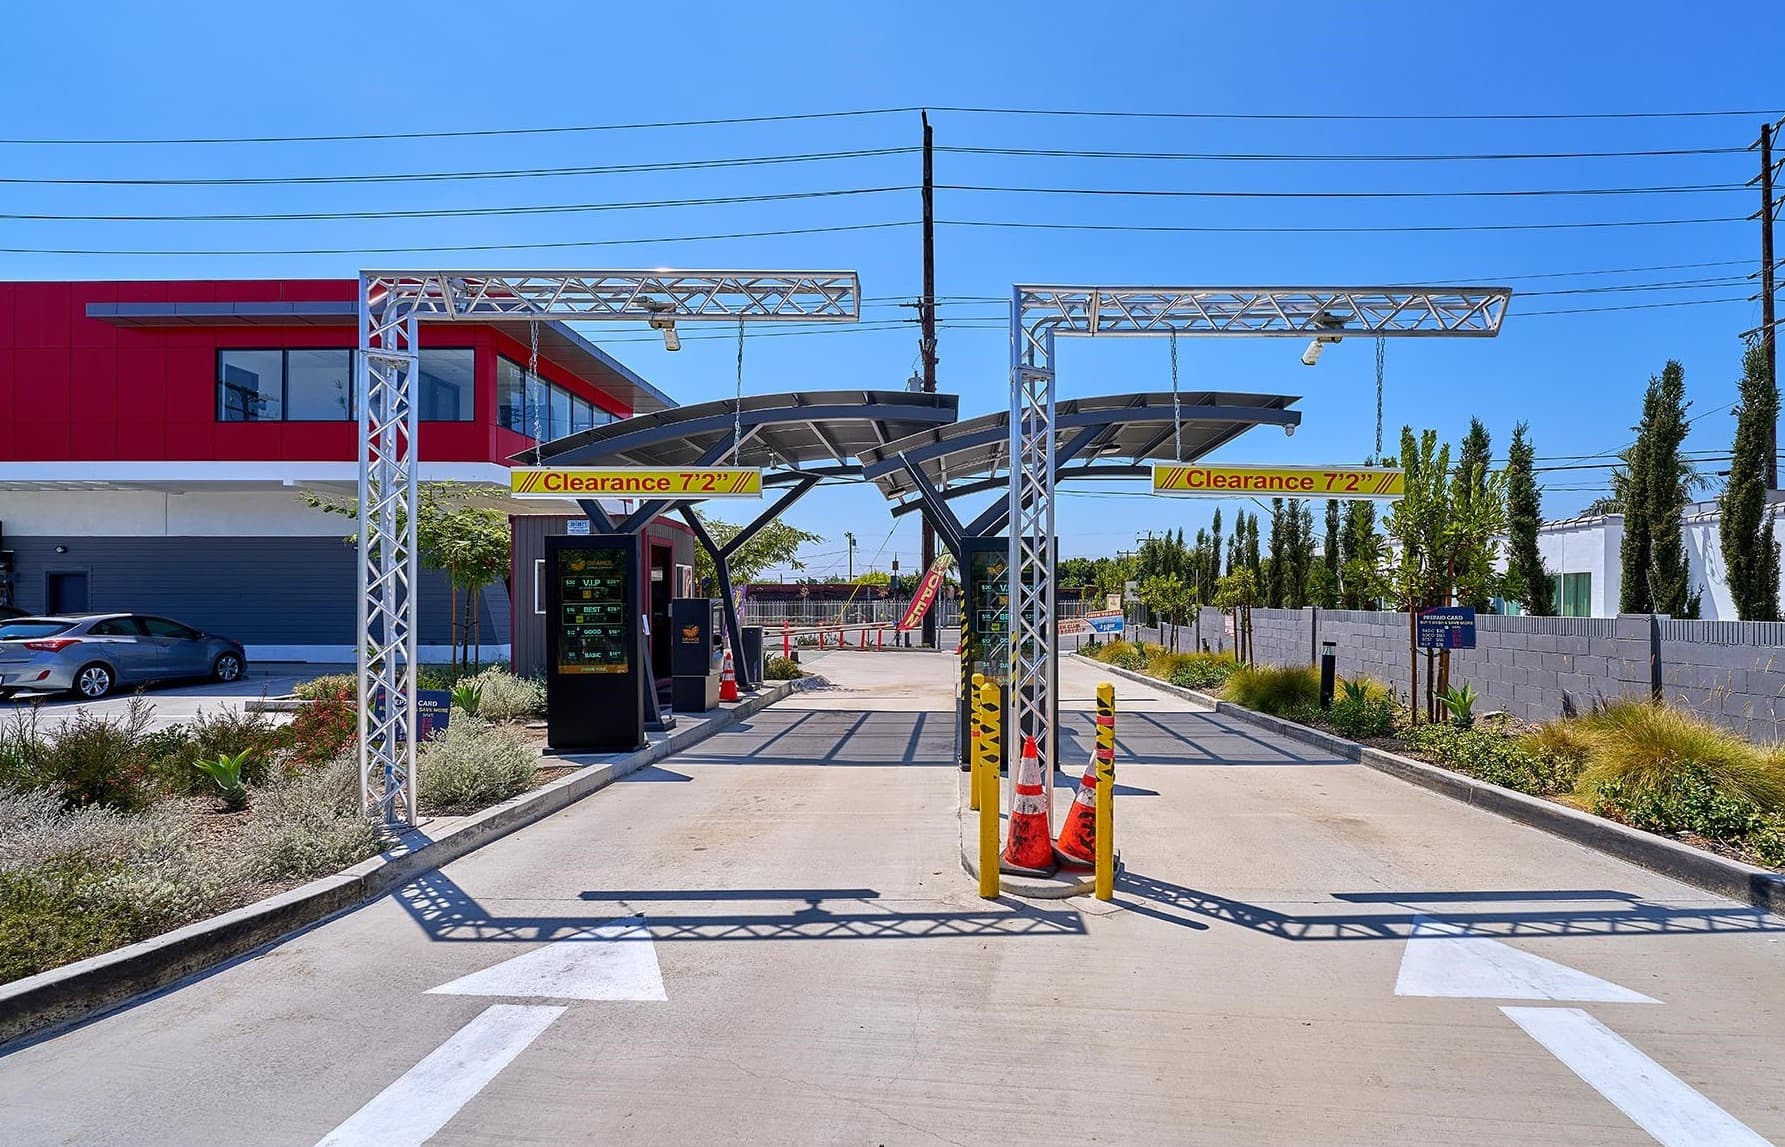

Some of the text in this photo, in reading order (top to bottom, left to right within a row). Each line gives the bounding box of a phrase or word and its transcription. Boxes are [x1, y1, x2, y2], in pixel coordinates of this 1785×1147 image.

[543, 473, 671, 491] Clearance
[1186, 469, 1314, 491] Clearance
[904, 573, 940, 626] OPEN
